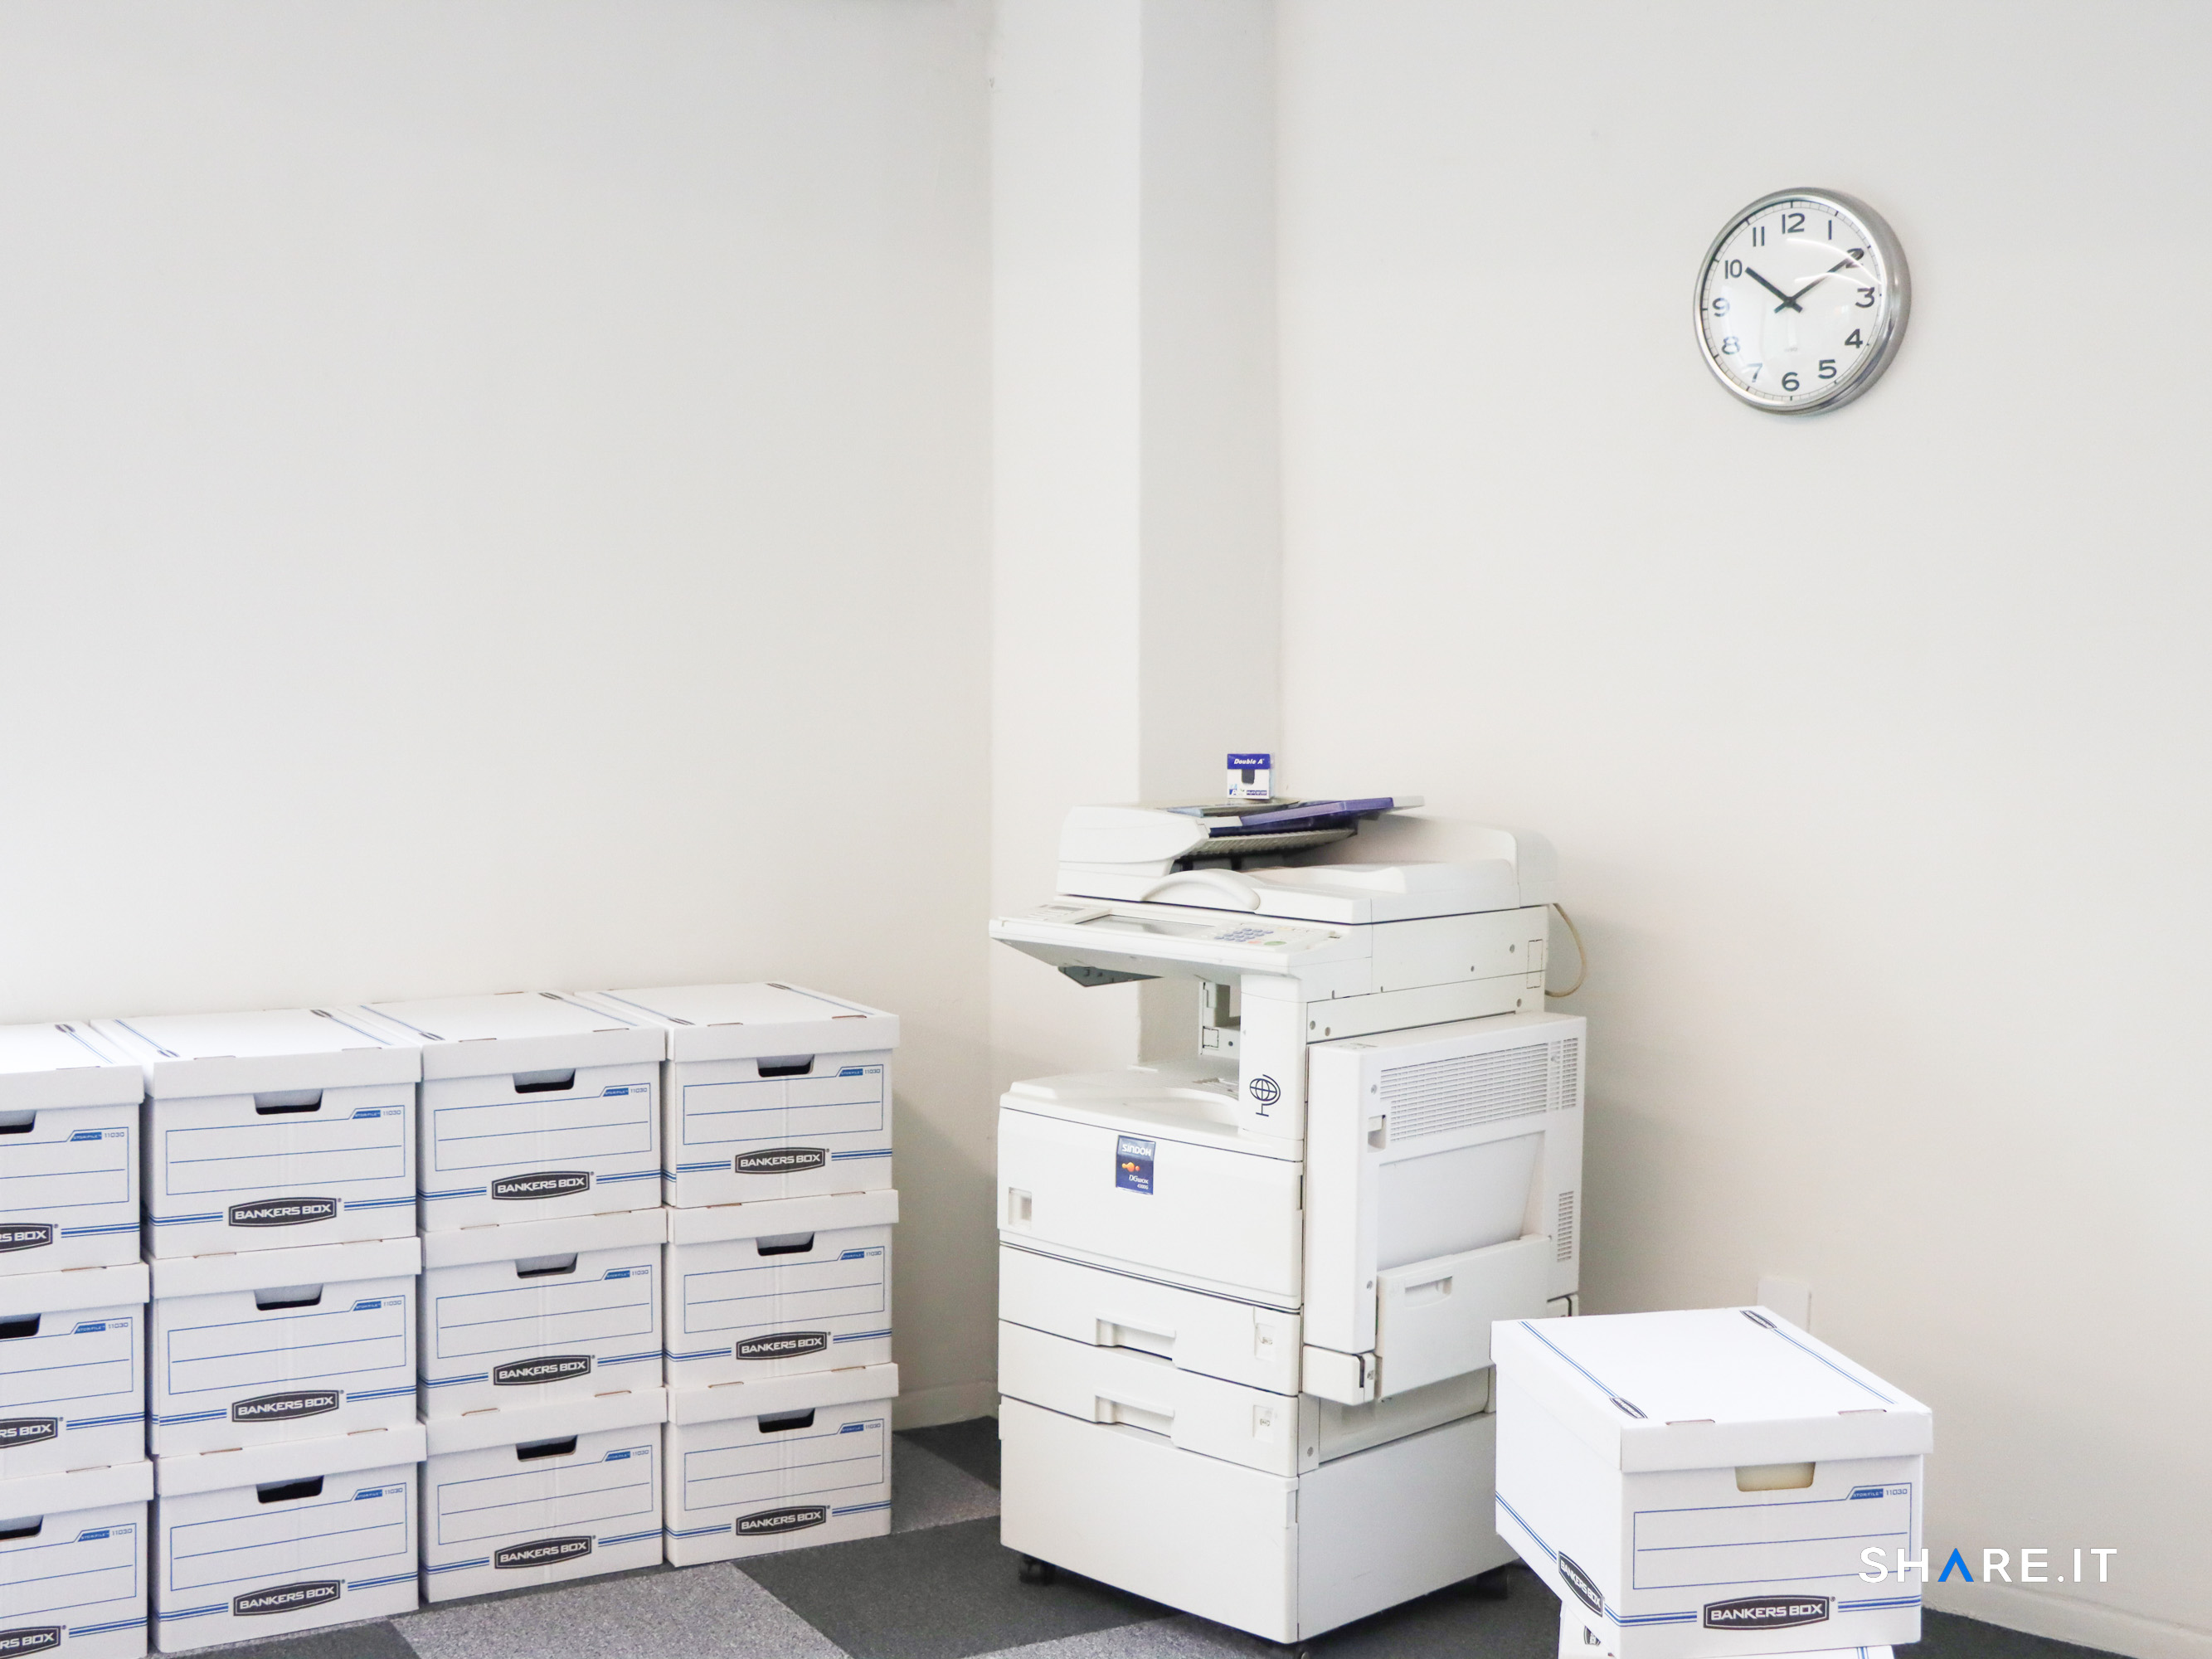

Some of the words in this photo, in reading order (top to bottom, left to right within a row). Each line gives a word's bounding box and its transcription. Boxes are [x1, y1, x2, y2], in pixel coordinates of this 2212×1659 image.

[1782, 212, 1805, 234] 12
[1828, 220, 1832, 240] 1
[1753, 226, 1765, 247] 11
[1724, 259, 1743, 280] 10
[1712, 297, 1730, 317] 9
[1855, 286, 1875, 309] 3
[1721, 336, 1740, 355] 8
[1844, 328, 1864, 348] 4
[1746, 362, 1762, 382] 7
[1818, 359, 1836, 379] 5
[1782, 372, 1800, 392] 6
[1122, 1144, 1152, 1156] SINDOH
[741, 1155, 795, 1167] BANKERS
[795, 1154, 820, 1162] BOX
[498, 1180, 557, 1193] BANKERS
[558, 1177, 585, 1187] BOX
[235, 1208, 300, 1220] BANKERS
[302, 1204, 332, 1214] BOX
[14, 1230, 46, 1242] BOX
[741, 1341, 796, 1354] BANKERS
[797, 1337, 821, 1348] BOX
[499, 1364, 558, 1379] BANKERS
[560, 1361, 586, 1371] BOX
[238, 1399, 303, 1415] BANKERS
[304, 1396, 333, 1408] BOX
[19, 1423, 52, 1436] BOX
[741, 1515, 795, 1530] BANKERS
[797, 1511, 821, 1521] BOX
[500, 1546, 558, 1562] BANKERS
[561, 1542, 586, 1553] BOX
[1560, 1559, 1587, 1594] BANKERS
[1587, 1587, 1601, 1608] BOX
[240, 1593, 304, 1609] BANKERS
[307, 1587, 335, 1598] BOX
[1711, 1607, 1787, 1621] BANKERS
[1789, 1603, 1823, 1615] BOX
[22, 1632, 55, 1646] BOX
